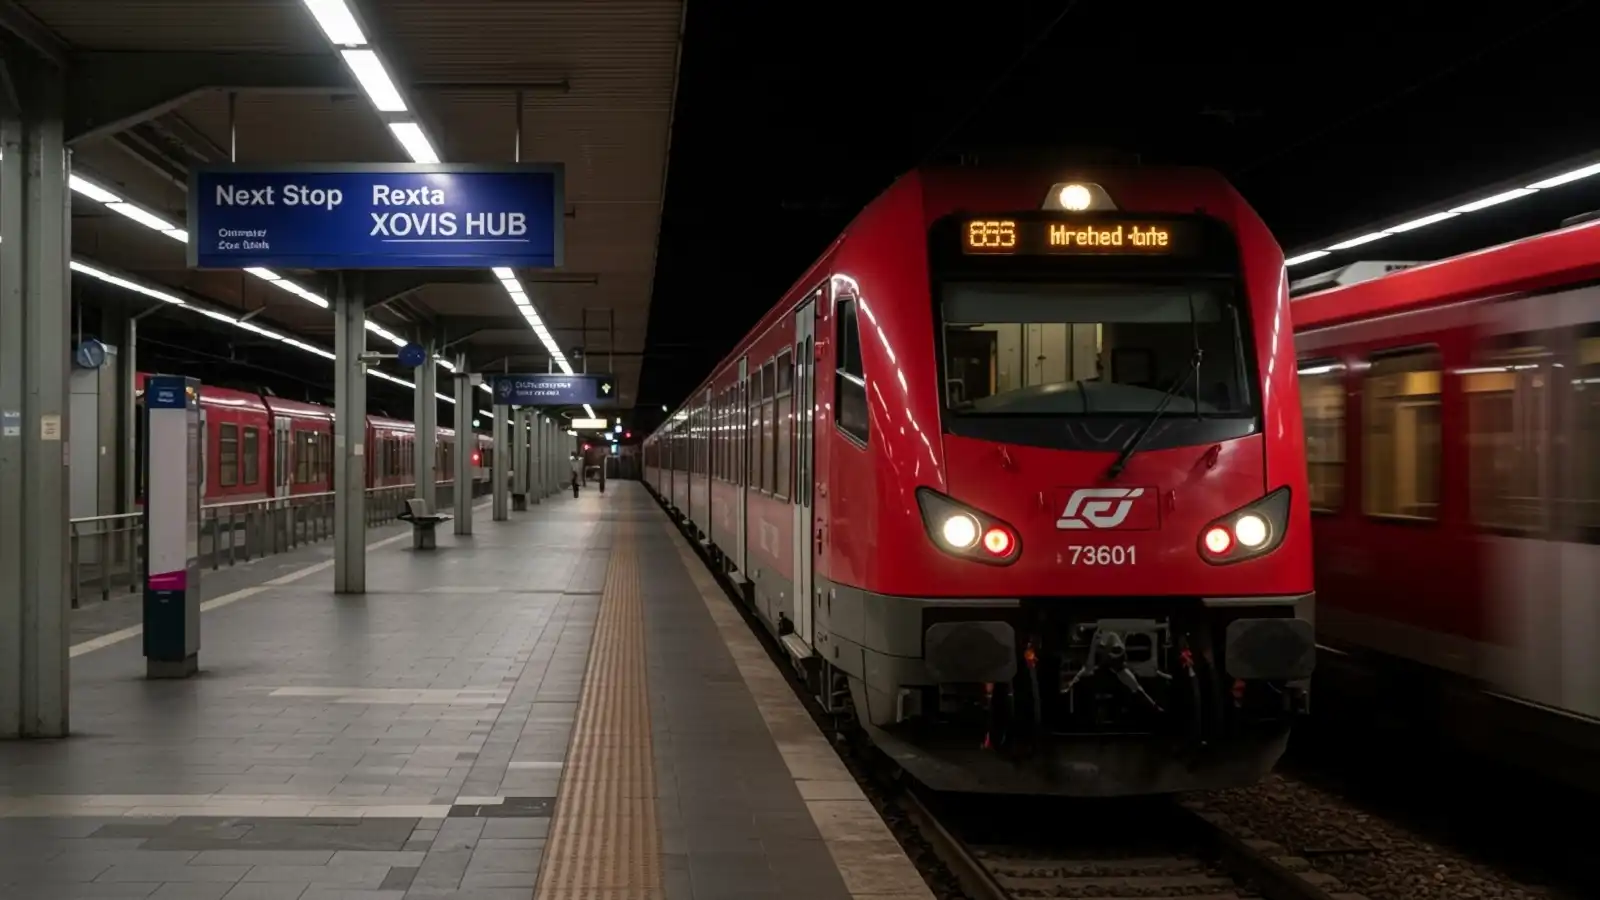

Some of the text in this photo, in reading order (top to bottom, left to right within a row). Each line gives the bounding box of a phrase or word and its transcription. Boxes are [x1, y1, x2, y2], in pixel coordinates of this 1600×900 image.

[216, 185, 343, 210] Next Stop
[372, 185, 445, 206] Rexta
[370, 211, 527, 236] XOVIS HUB
[1068, 545, 1136, 565] 73601
